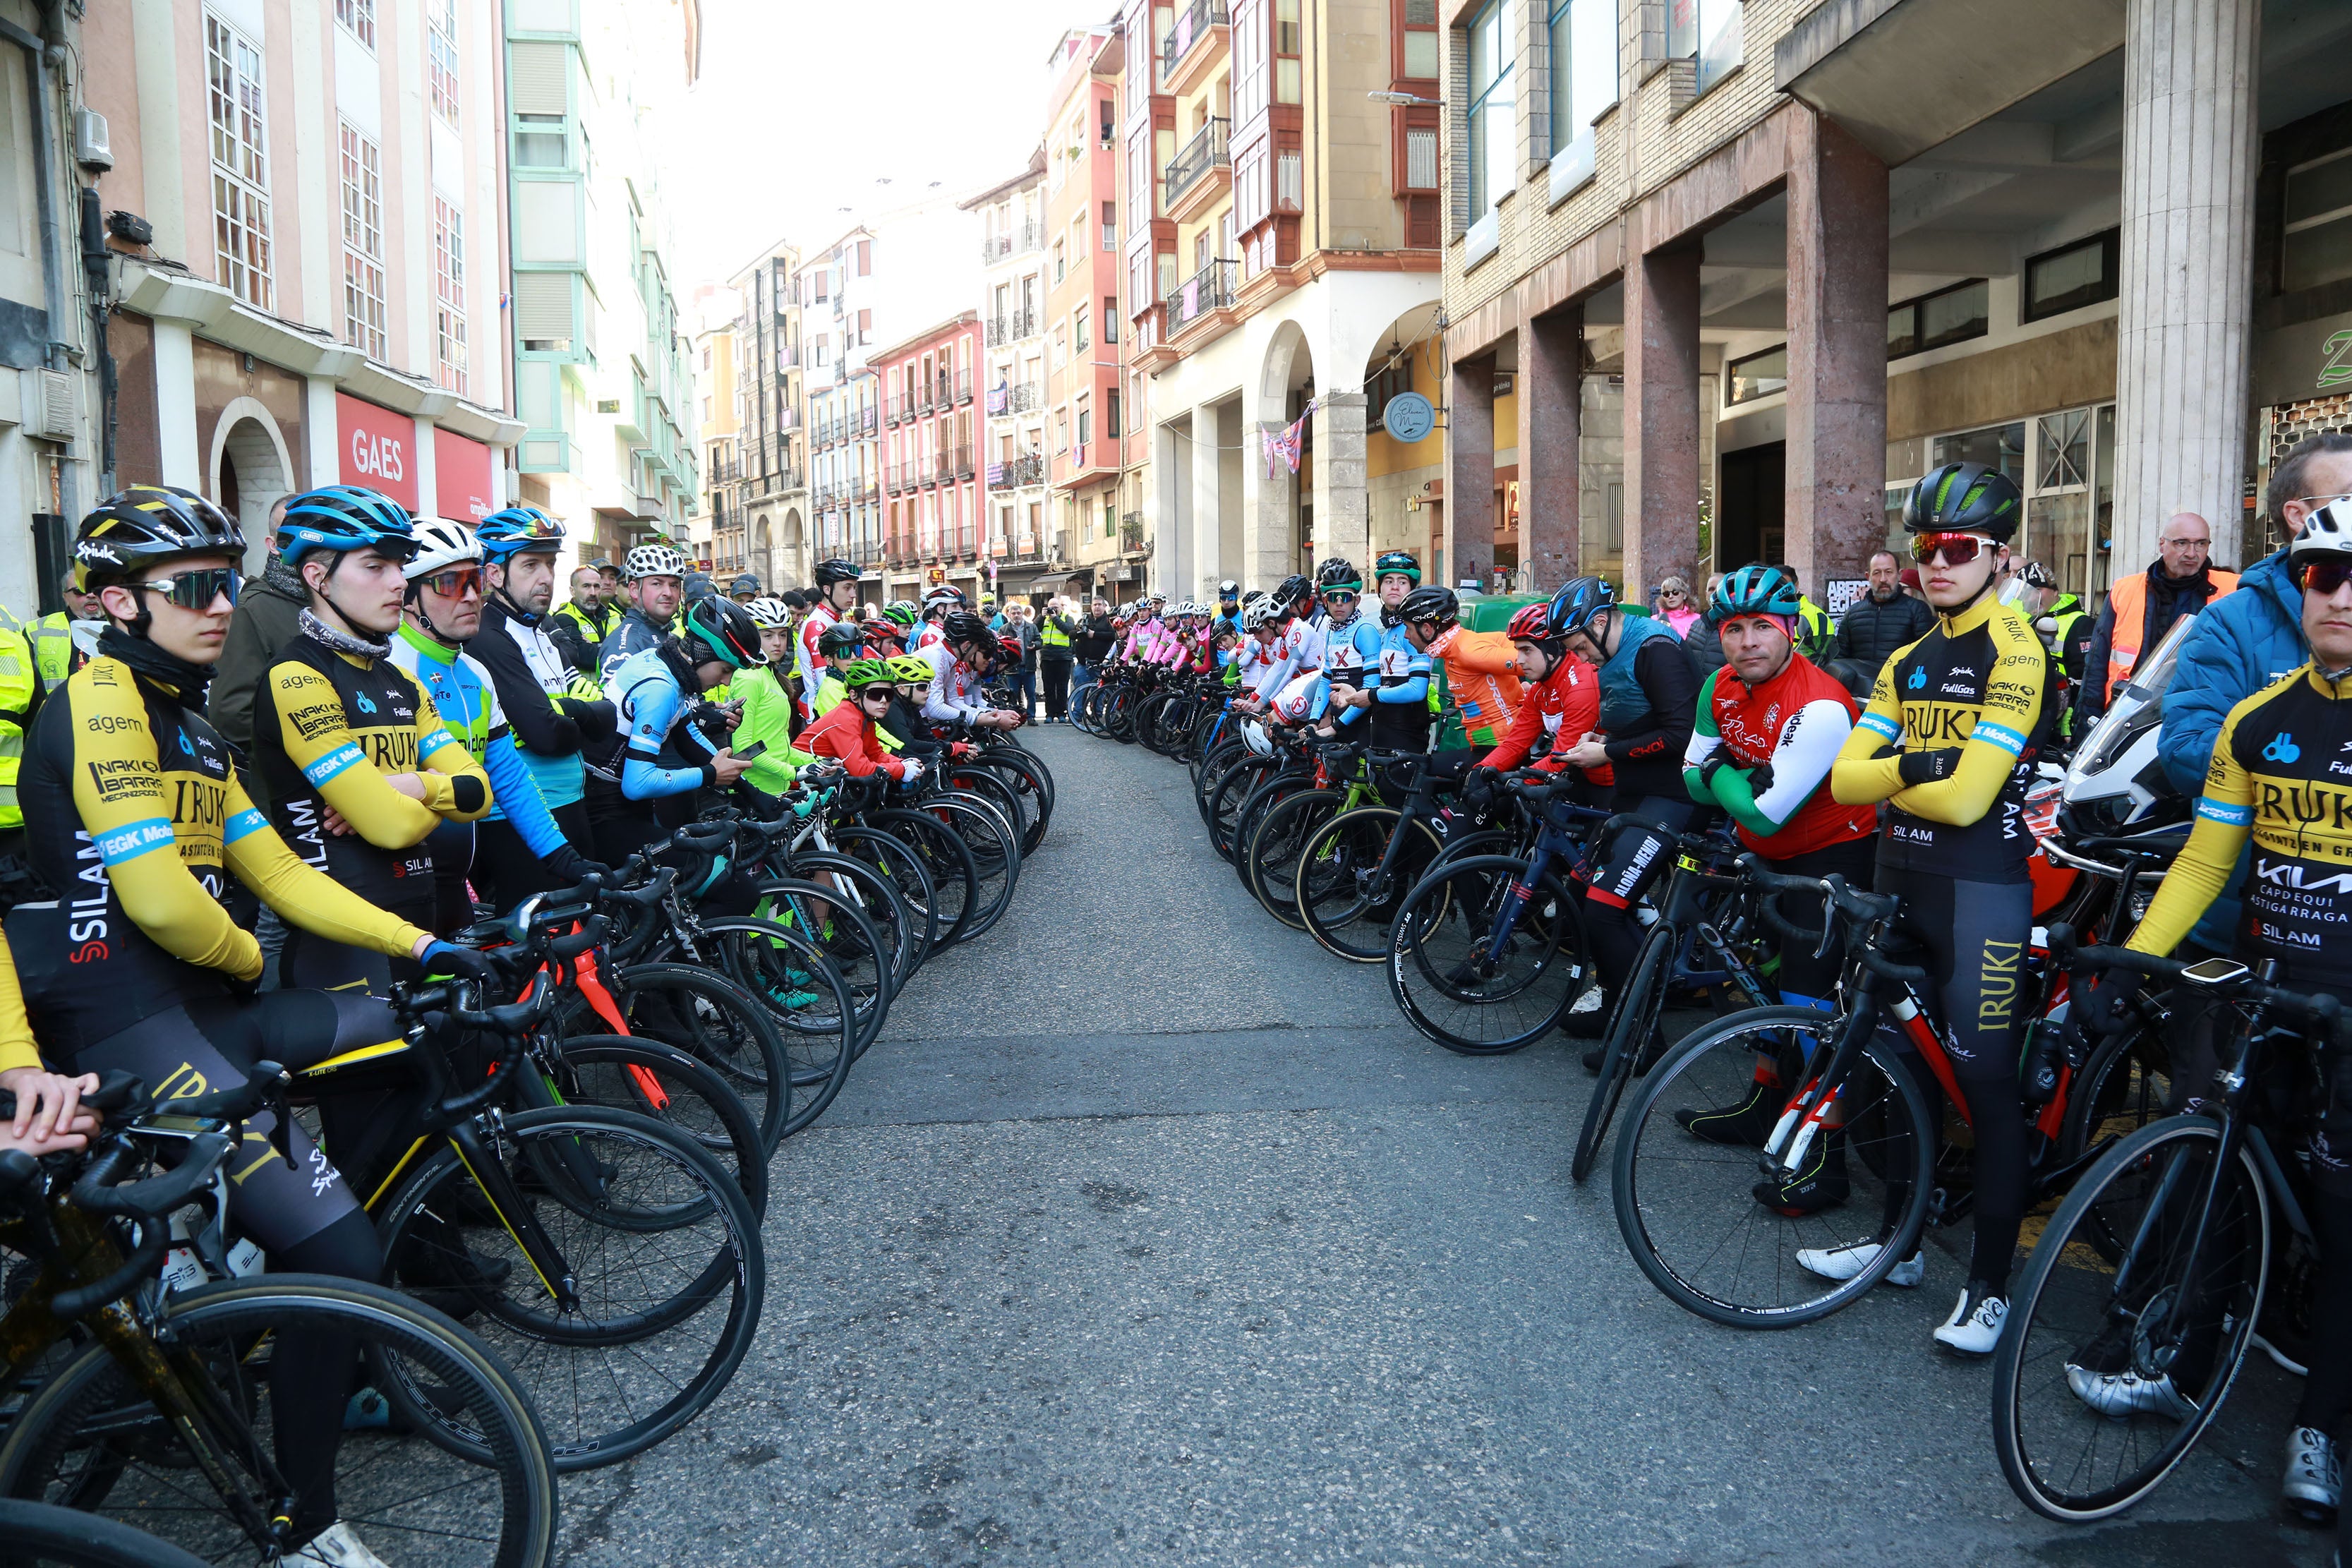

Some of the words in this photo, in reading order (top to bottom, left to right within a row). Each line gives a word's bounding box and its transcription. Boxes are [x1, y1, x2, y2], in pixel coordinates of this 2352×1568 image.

[353, 428, 403, 482] GAES
[155, 524, 183, 546] Spiuk
[302, 532, 321, 541] ABUS
[76, 540, 123, 565] Spiuk
[2003, 616, 2029, 643] IRUKI
[1948, 667, 1974, 677] Spiuk
[1486, 673, 1513, 725] ORBEA
[1941, 683, 1974, 694] FullGas
[393, 708, 413, 716] FullGas
[203, 756, 224, 771] FullGas
[315, 758, 342, 778] EGK
[101, 790, 159, 804] MECANIZADOS
[109, 831, 142, 856] EGK
[287, 799, 329, 873] ILAM
[1614, 835, 1662, 898] ALOÑA-MENDI
[1398, 923, 1407, 943] SWISS
[1978, 939, 2022, 1032] IRUKI
[309, 1068, 326, 1077] X-LITE
[389, 1163, 442, 1223] CONTINENTAL
